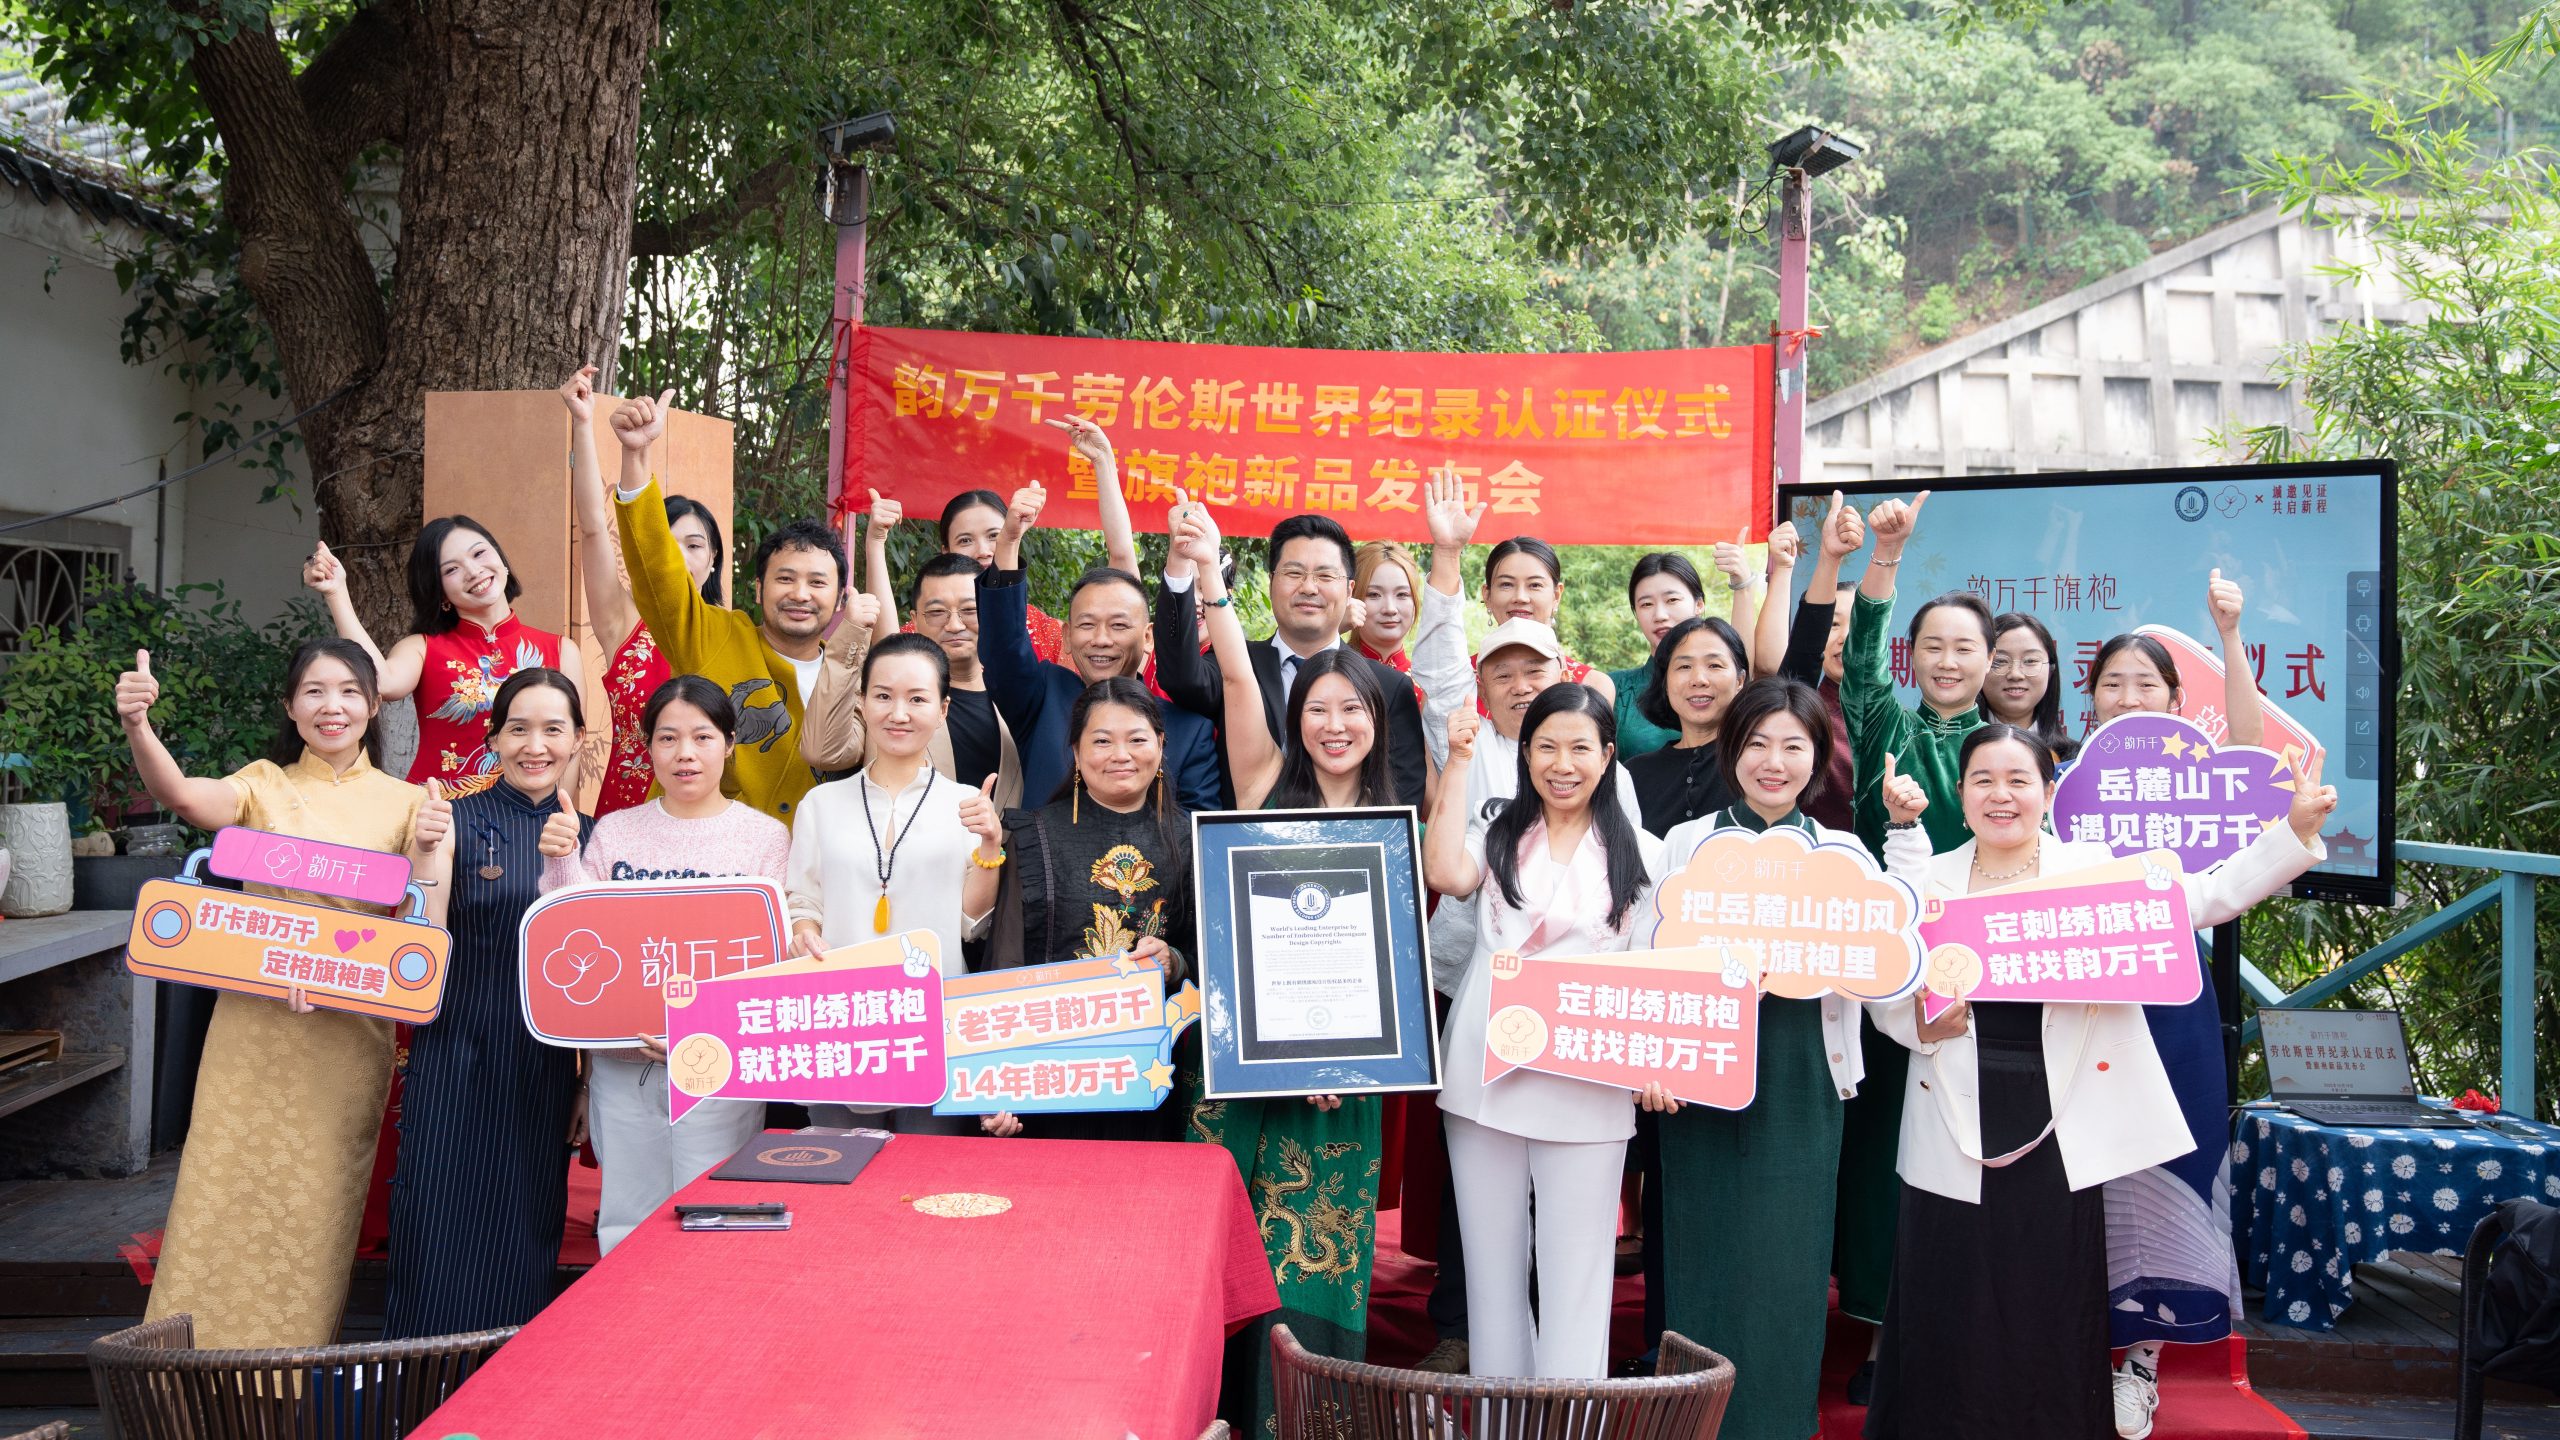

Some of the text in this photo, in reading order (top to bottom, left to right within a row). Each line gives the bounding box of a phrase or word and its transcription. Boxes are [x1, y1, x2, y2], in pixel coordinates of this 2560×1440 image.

[893, 363, 1732, 440] 韵万千劳伦斯世界纪录认证仪式
[2272, 500, 2327, 514] 共启新程
[1967, 574, 2123, 613] 韵万千旗袍
[2124, 735, 2158, 750] 韵万千
[2097, 766, 2250, 803] 岳麓山下
[2069, 813, 2262, 849] 遇见韵万千
[307, 853, 368, 885] 韵万千
[1754, 857, 1808, 880] 韵万千
[199, 901, 315, 943] 打卡韵万千
[1680, 889, 1898, 935] 把岳麓山的风
[1982, 899, 2175, 945] 定刺绣旗袍
[264, 950, 386, 993] 定格旗袍美
[640, 936, 764, 987] 韵万千
[1493, 955, 1518, 971] GO
[1697, 934, 1877, 980] 旗袍里
[1987, 940, 2179, 987] 就找韵万千
[667, 981, 692, 998] GO
[1556, 981, 1741, 1030] 定刺绣旗袍
[736, 986, 928, 1036] 定刺绣旗袍
[958, 987, 1151, 1043] 老字号韵万千
[737, 1036, 929, 1084] 就找韵万千
[1552, 1025, 1738, 1076] 就找韵万千
[2270, 1045, 2396, 1059] 劳伦斯世界纪录认证仪式
[954, 1058, 1136, 1098] 14年韵万千
